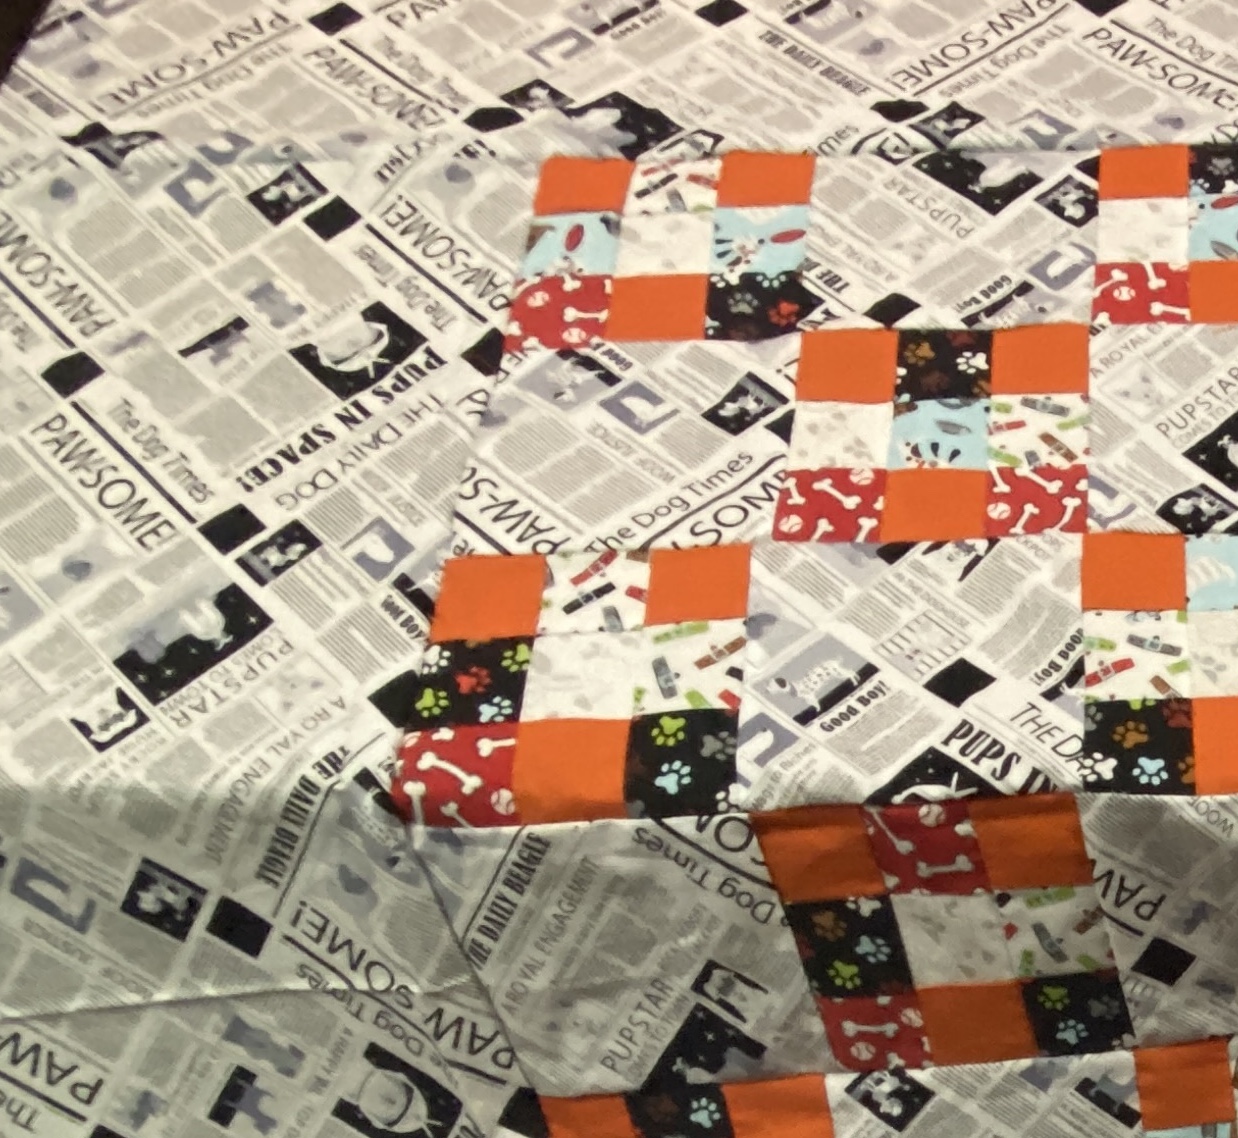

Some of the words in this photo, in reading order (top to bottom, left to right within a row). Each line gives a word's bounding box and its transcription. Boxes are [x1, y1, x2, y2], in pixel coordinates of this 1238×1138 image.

[371, 346, 445, 404] PUPS
[131, 419, 171, 465] Dog
[337, 400, 374, 432] IN
[236, 422, 339, 492] SPACE!
[341, 428, 402, 472] DAILY
[276, 468, 339, 509] DOG
[586, 522, 634, 555] The
[632, 485, 682, 529] Dog
[678, 450, 752, 507] Times
[166, 634, 293, 728] PUPSTAR
[1035, 653, 1072, 686] Boy!
[819, 702, 860, 734] Good
[851, 680, 890, 715] Boy!
[1008, 702, 1056, 745] THE
[313, 745, 350, 778] THE
[941, 721, 1008, 780] PUPS
[201, 752, 276, 866] ENGAGEMENT
[284, 774, 324, 837] DAILY
[256, 828, 302, 888] BEAGLE
[481, 879, 514, 936] DAILY
[505, 833, 551, 892] BEAGLE
[630, 826, 711, 892] Times
[715, 876, 779, 927] Dog
[602, 976, 672, 1075] PUPSTAR
